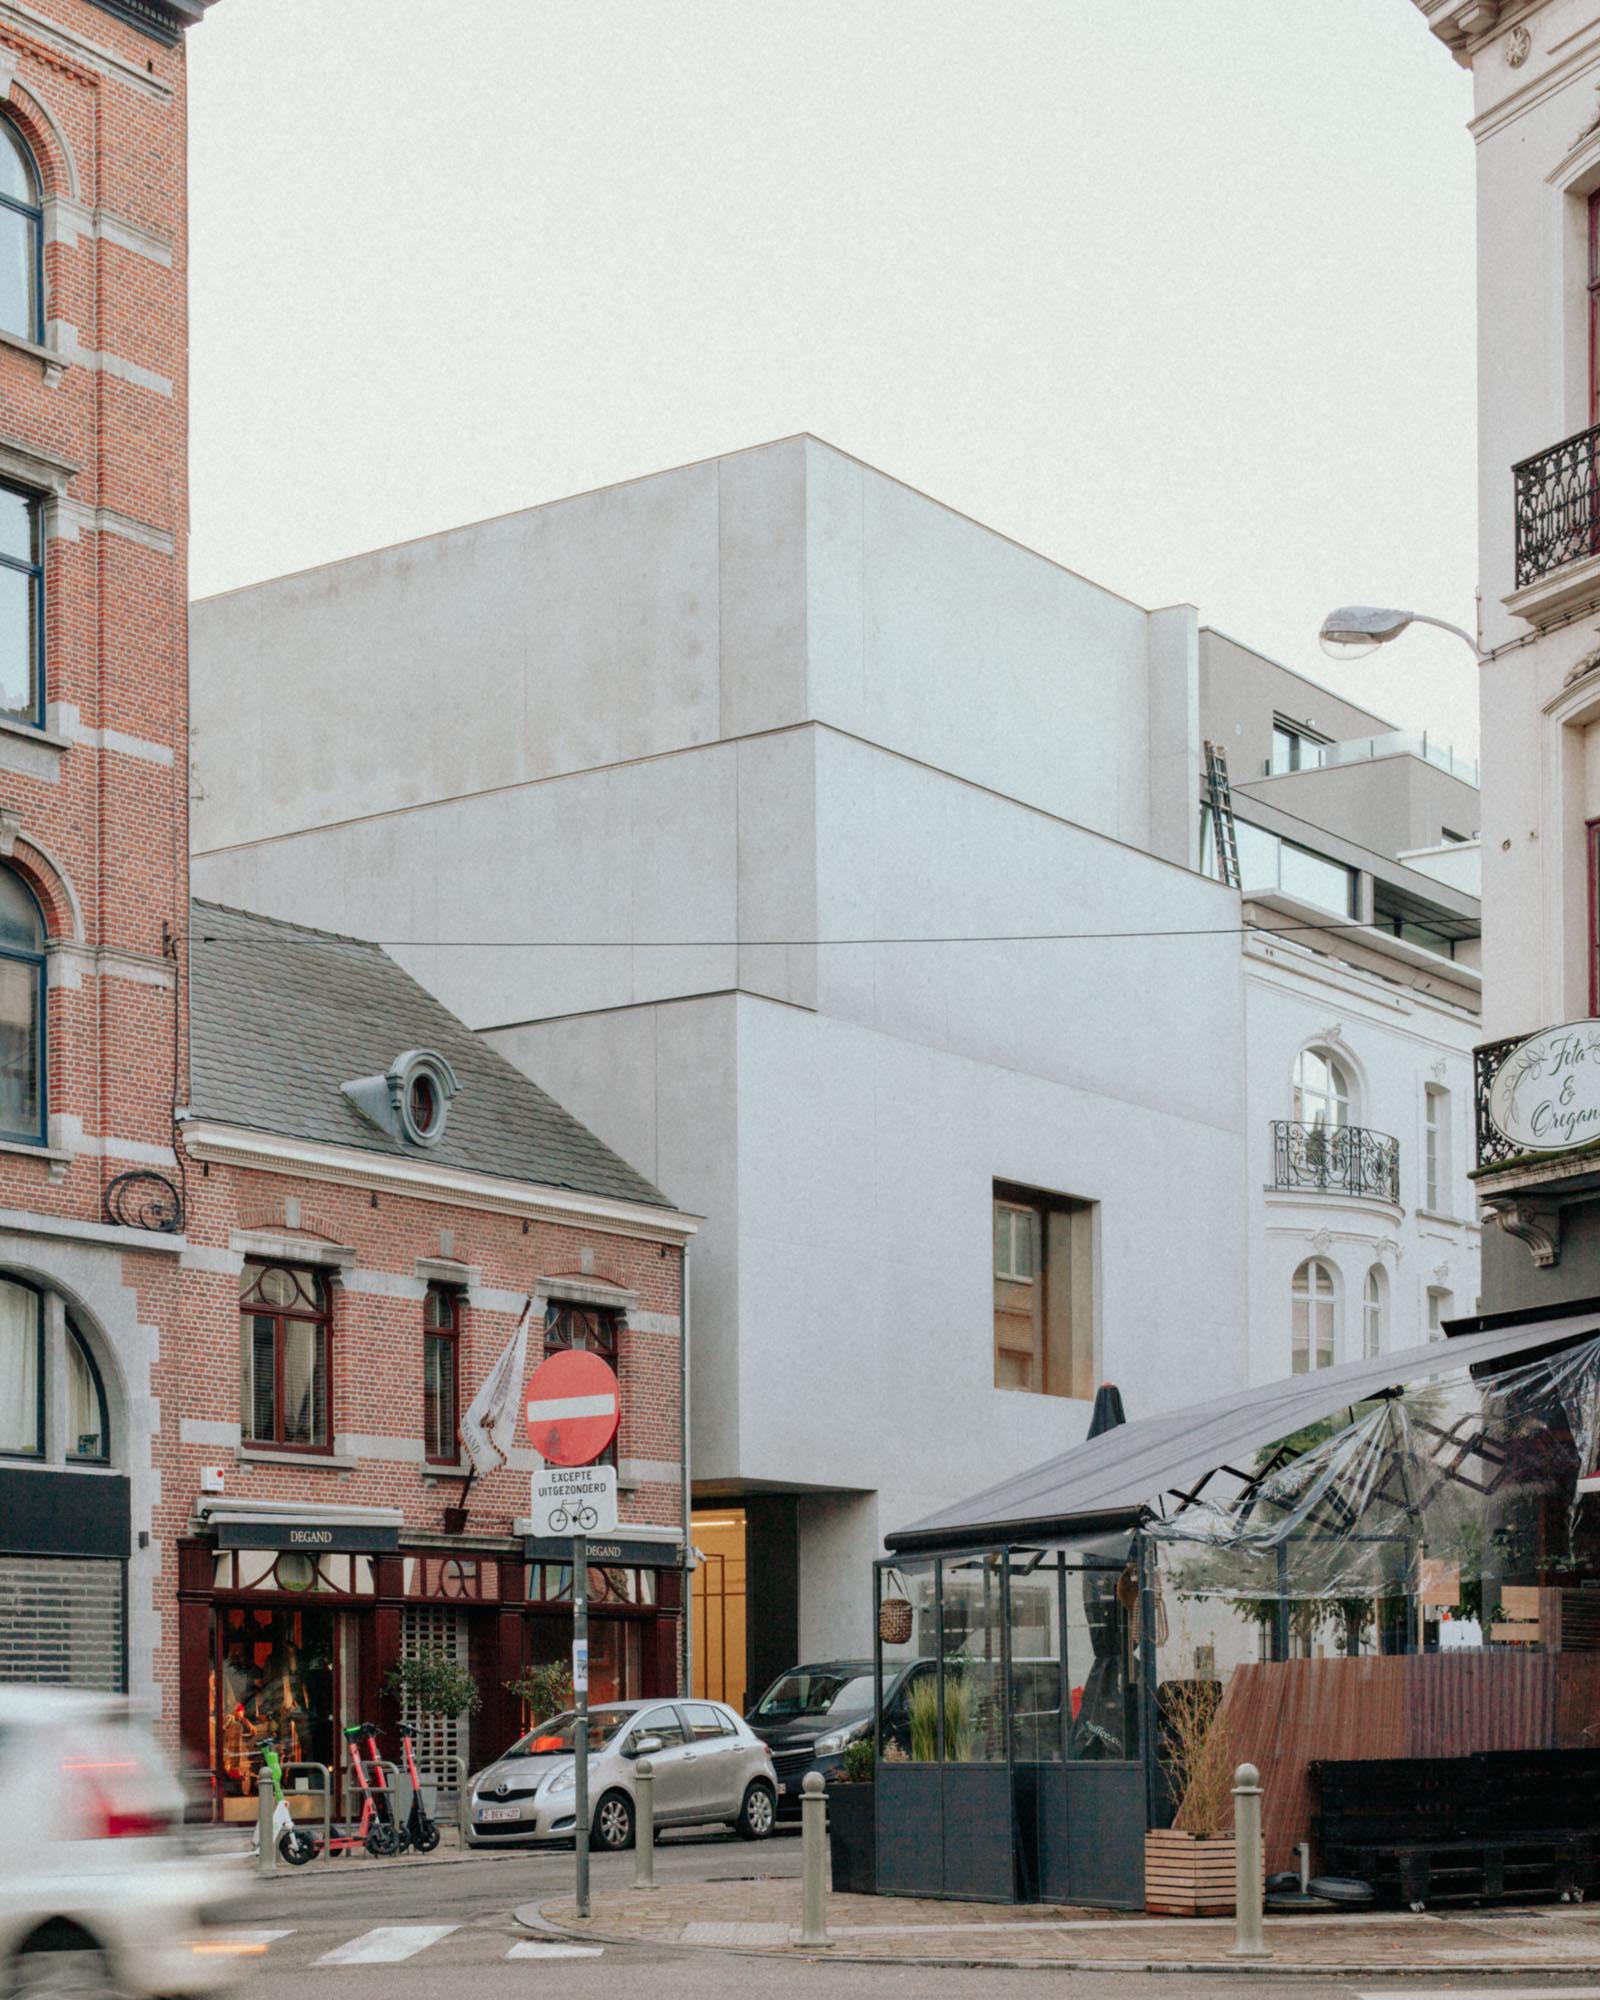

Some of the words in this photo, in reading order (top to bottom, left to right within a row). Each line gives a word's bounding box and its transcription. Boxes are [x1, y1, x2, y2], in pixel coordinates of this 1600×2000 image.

[1549, 1033, 1585, 1076] Feta
[1559, 1075, 1576, 1106] &
[1530, 1099, 1600, 1141] Oregan
[551, 1471, 593, 1483] EXCEPTE
[538, 1483, 607, 1497] UITGEZONDERD
[290, 1530, 333, 1543] DEGAND
[585, 1545, 621, 1557] DEGAND
